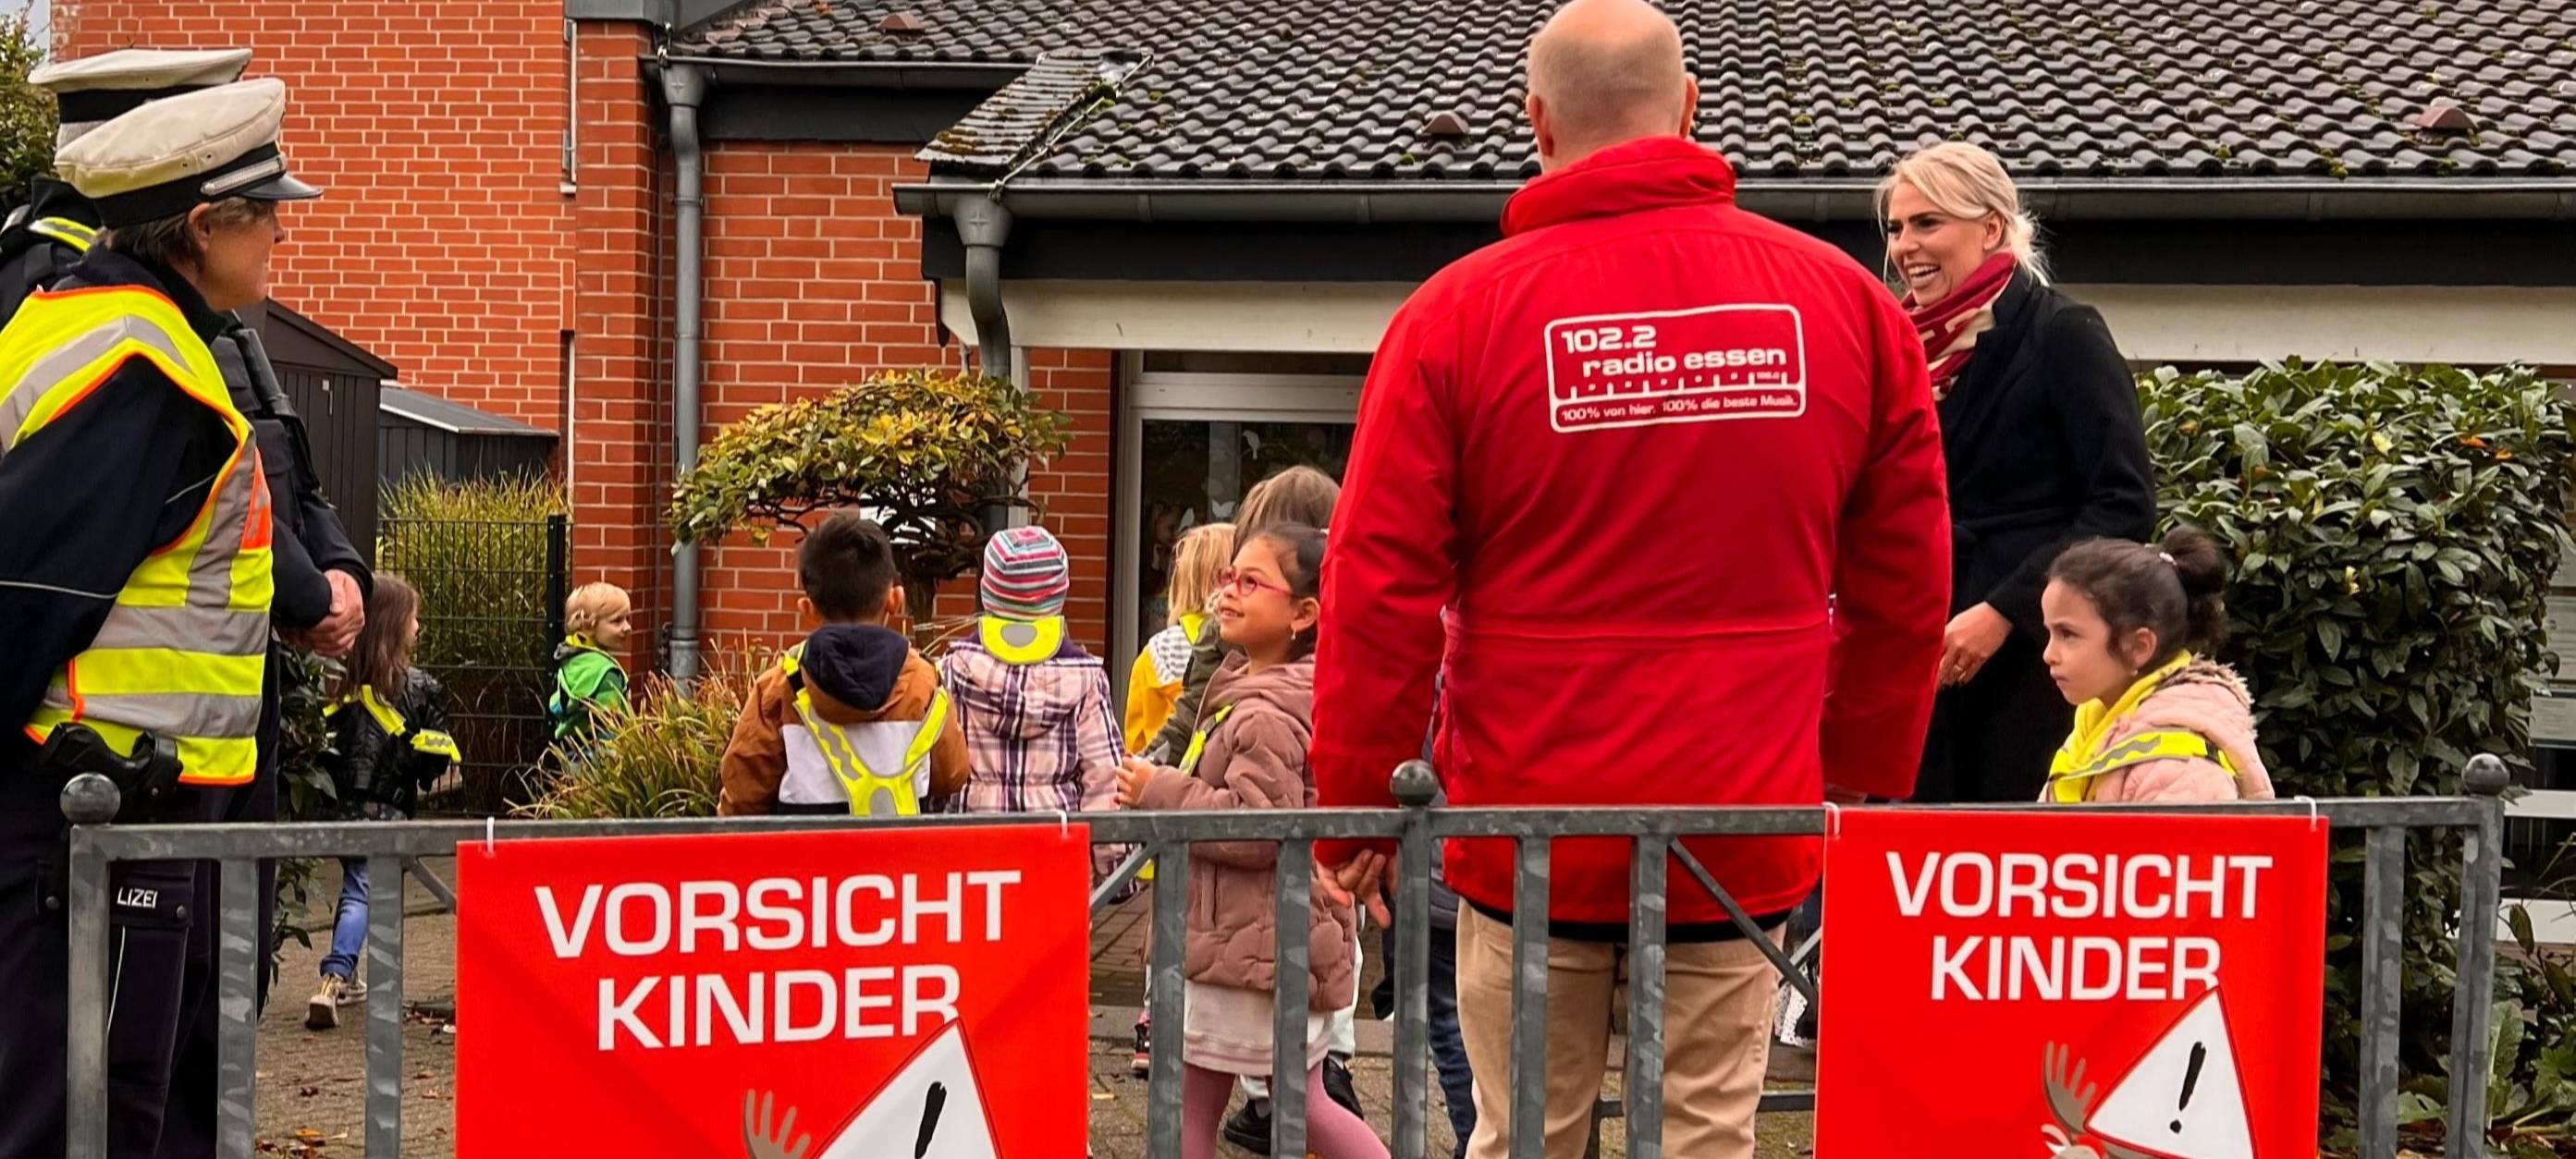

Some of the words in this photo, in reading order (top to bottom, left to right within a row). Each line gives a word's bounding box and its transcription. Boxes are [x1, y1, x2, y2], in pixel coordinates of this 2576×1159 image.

[1561, 325, 1657, 354] 102.2
[1583, 351, 1677, 378] radio
[1684, 348, 1787, 370] essen
[1562, 406, 1601, 421] 100%
[1603, 407, 1625, 418] von
[1629, 404, 1656, 415] hier.
[1662, 398, 1699, 412] 100%
[1701, 397, 1721, 410] die
[1723, 396, 1758, 409] beste
[1760, 395, 1798, 407] Musik.
[117, 887, 158, 909] LIZEI
[1886, 851, 2273, 919] VORSICHT
[534, 870, 1022, 958] VORSICHT
[1931, 935, 2220, 1001] KINDER
[597, 964, 960, 1051] KINDER
